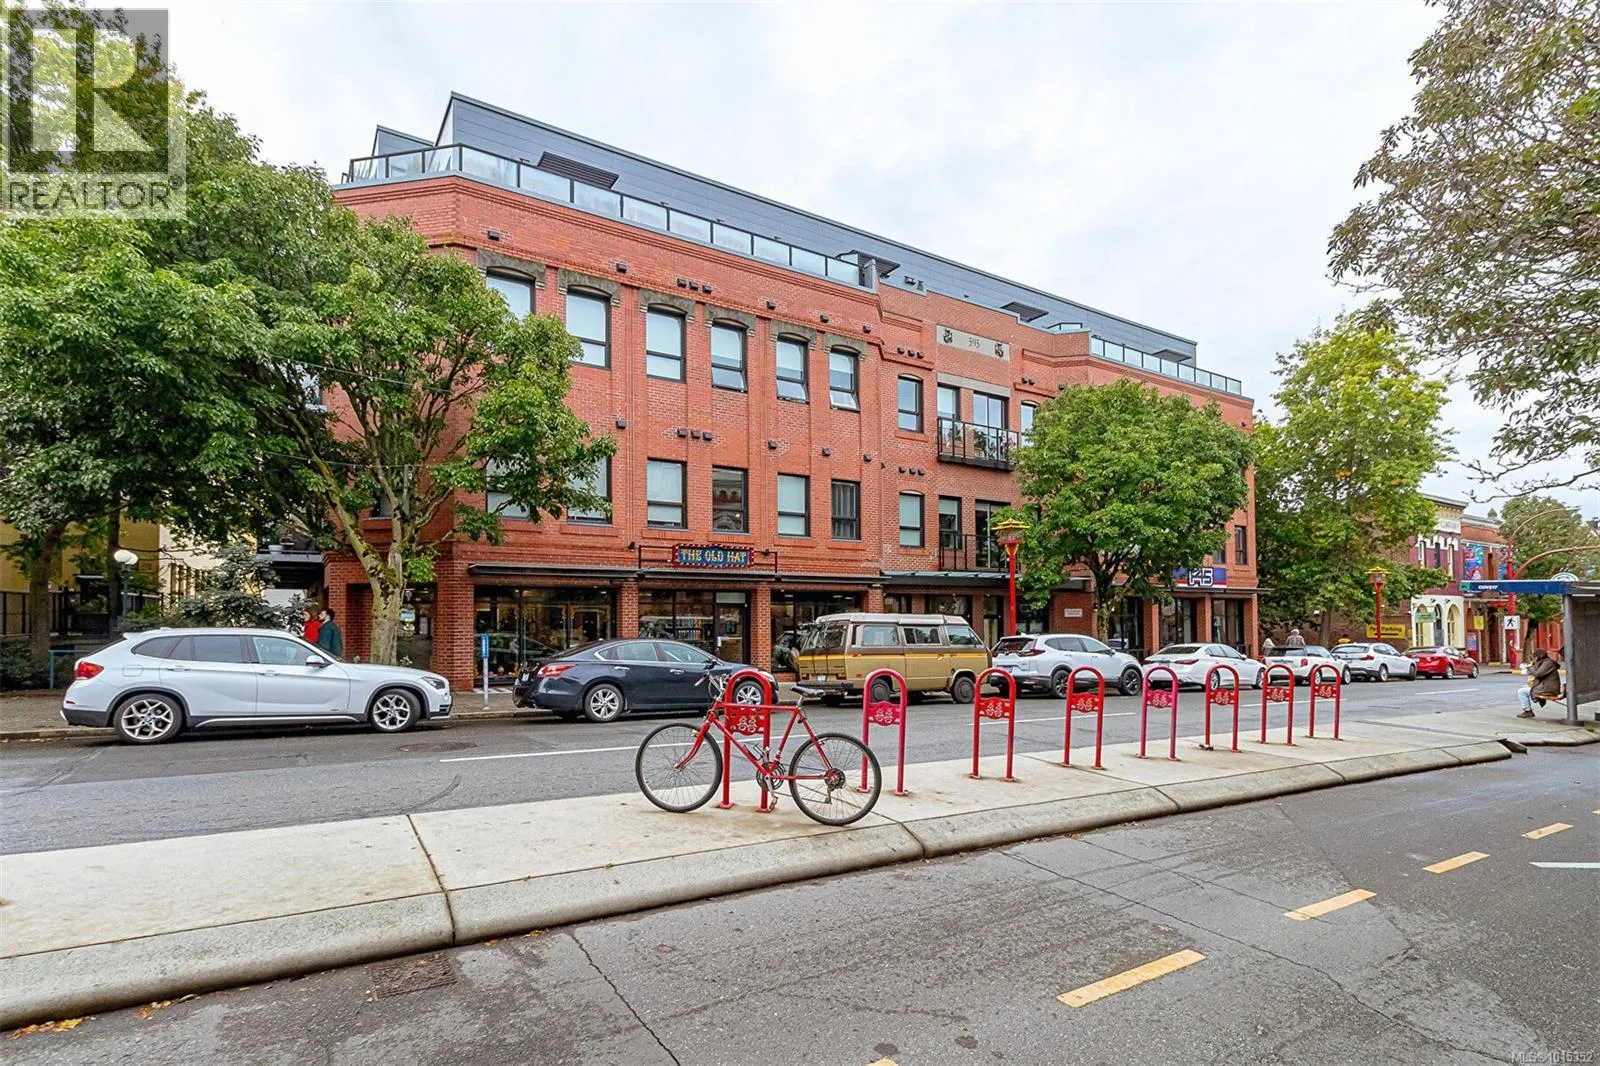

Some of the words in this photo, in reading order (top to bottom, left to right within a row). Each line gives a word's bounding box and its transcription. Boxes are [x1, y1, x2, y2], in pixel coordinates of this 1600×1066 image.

[680, 548, 702, 562] THE
[704, 549, 724, 563] OLD
[726, 551, 747, 564] HAT
